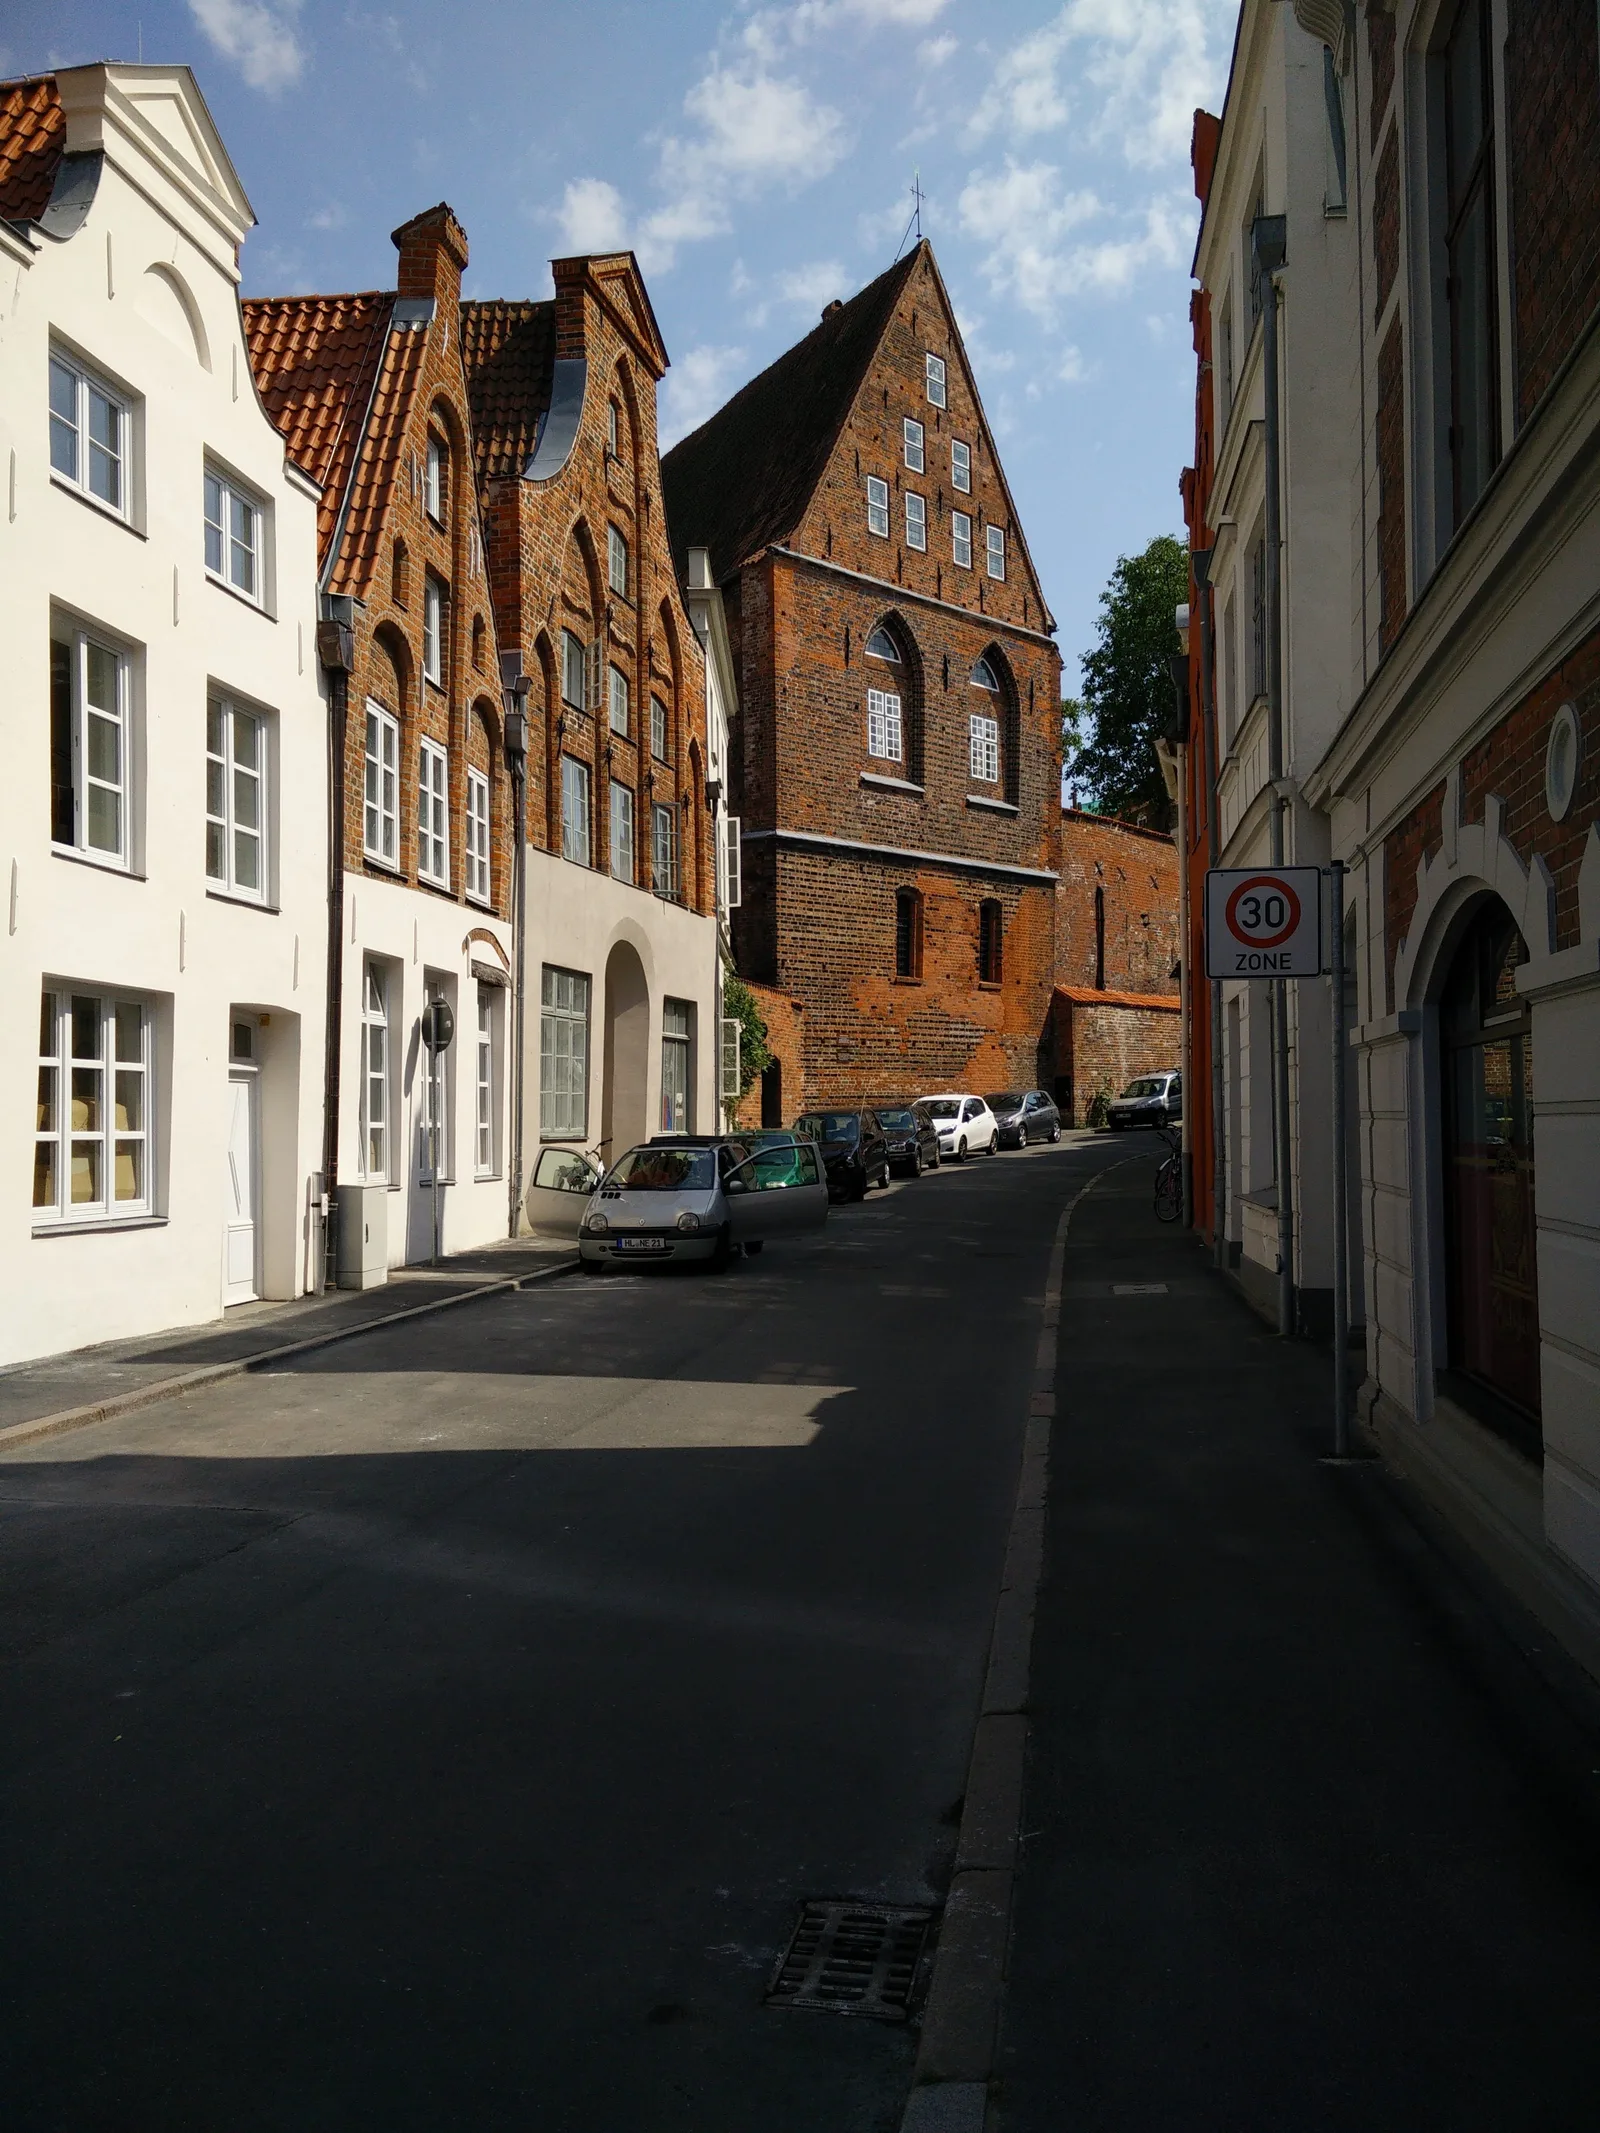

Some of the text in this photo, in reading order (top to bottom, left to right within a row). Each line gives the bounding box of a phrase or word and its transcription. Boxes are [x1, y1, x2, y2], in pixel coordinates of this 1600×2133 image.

[1241, 895, 1285, 929] 30
[1235, 952, 1292, 971] ZONE
[624, 1239, 661, 1247] HL NE 21
